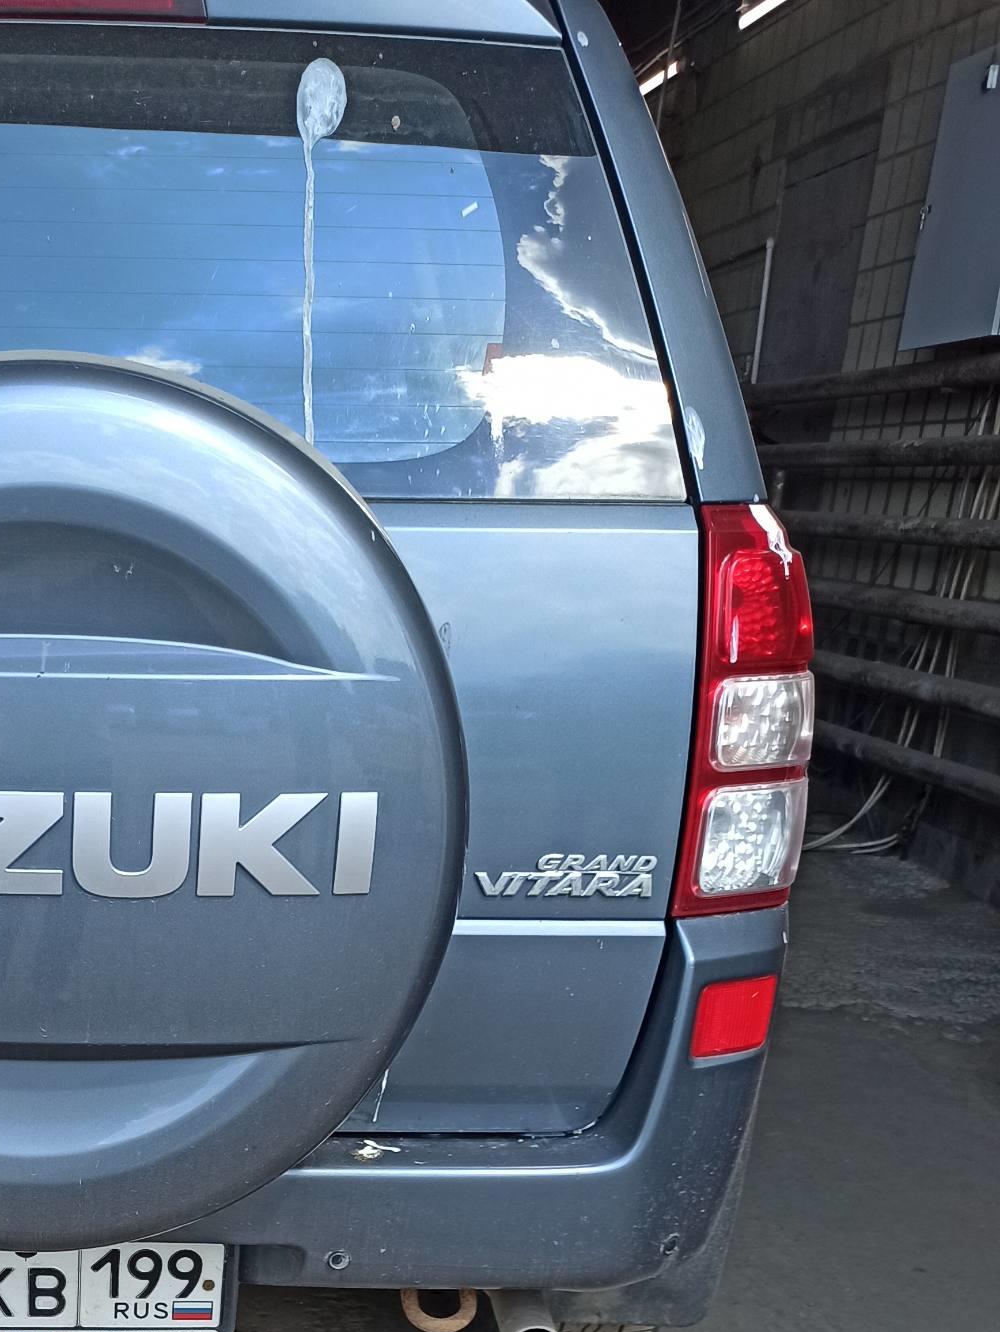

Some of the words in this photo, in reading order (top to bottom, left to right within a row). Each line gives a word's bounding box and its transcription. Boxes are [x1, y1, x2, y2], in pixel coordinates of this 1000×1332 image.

[537, 853, 658, 872] GRAND
[474, 871, 653, 897] VITARA
[90, 1248, 204, 1300] 199
[113, 1302, 170, 1320] RUS
